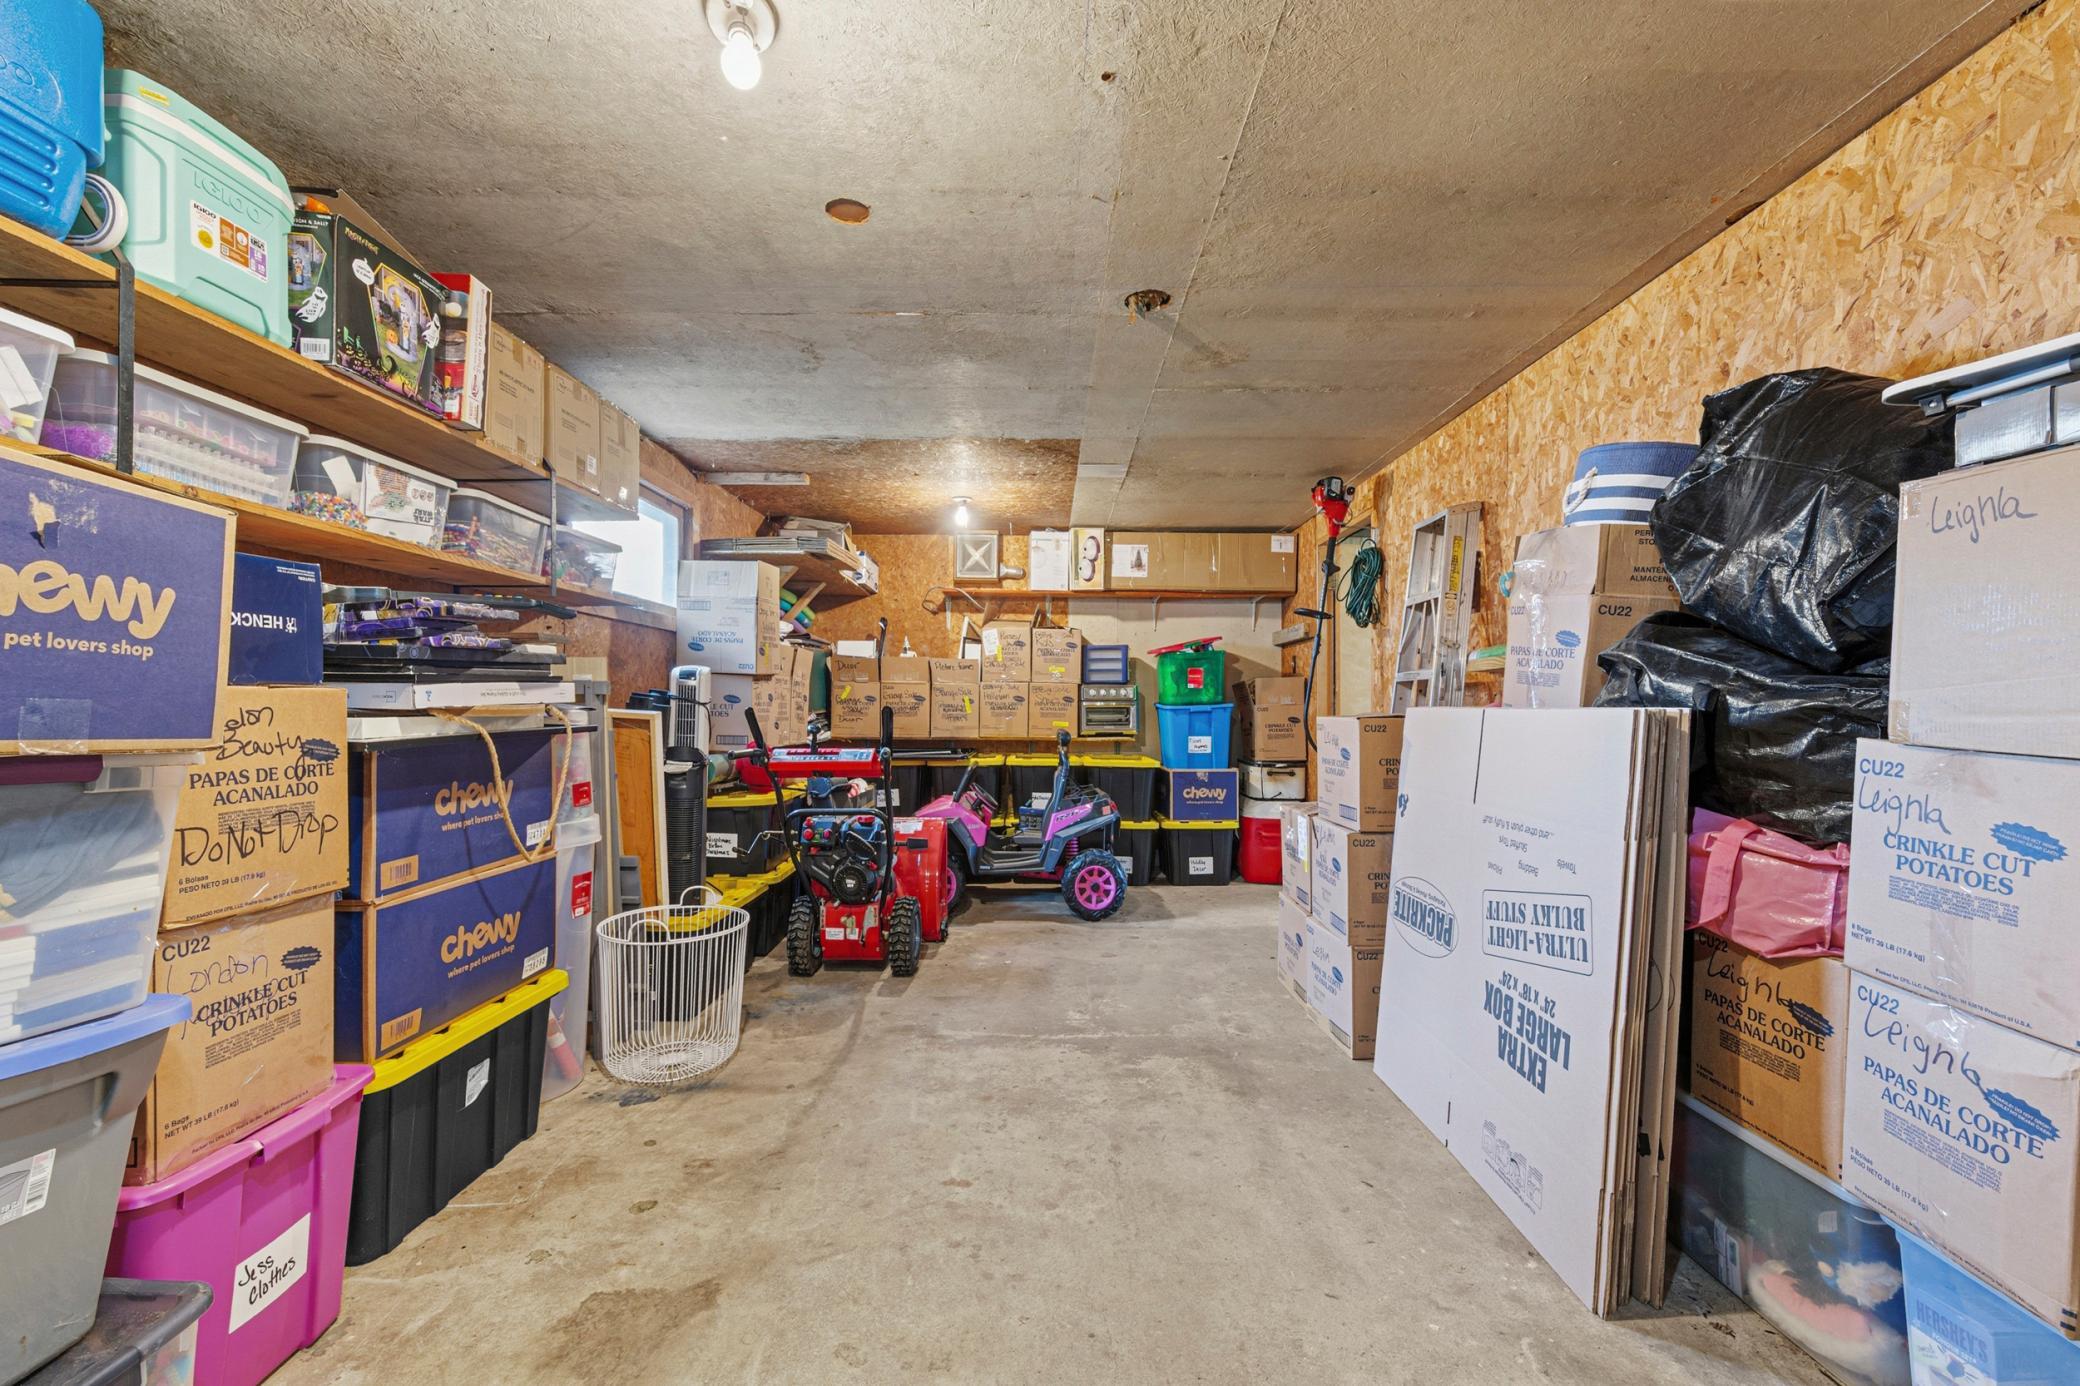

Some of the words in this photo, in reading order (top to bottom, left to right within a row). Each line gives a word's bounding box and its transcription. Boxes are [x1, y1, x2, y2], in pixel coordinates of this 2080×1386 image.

[1630, 575, 1672, 583] ALMACEN
[1633, 566, 1667, 574] MANTEN
[0, 560, 176, 640] ewy
[1598, 604, 1633, 617] CU22
[230, 611, 283, 630] HENCK
[4, 632, 42, 650] pet
[47, 632, 107, 654] lovers
[111, 638, 154, 661] shop
[1510, 646, 1532, 657] PAPAS
[1545, 646, 1576, 659] CORTE
[1516, 657, 1564, 670] ACALADO
[1363, 724, 1388, 733] CU22
[189, 768, 250, 790] PAPAS
[255, 766, 279, 783] DE
[283, 762, 335, 782] CORTE
[1378, 757, 1401, 767] CRIN
[1859, 758, 1905, 778] CU22
[213, 780, 319, 807] ACANALADO
[434, 779, 514, 816] chewy
[1182, 786, 1227, 801] chewy
[463, 817, 474, 829] pet
[1352, 838, 1377, 848] CU22
[1510, 839, 1528, 853] Stuffed
[1883, 831, 1975, 866] CRINKLE
[1982, 852, 2037, 878] CUT
[1367, 871, 1392, 881] CRIN
[1518, 859, 1539, 877] Bedding
[1556, 858, 1577, 875] Towels
[1896, 854, 2014, 896] POTATOES
[179, 885, 199, 895] PESO
[200, 880, 220, 891] NETO
[1394, 890, 1455, 949] PACKRITE
[1486, 900, 1527, 924] STUFF
[1530, 903, 1586, 932] BULKY
[162, 935, 211, 963] CU22
[440, 911, 521, 964] chewy
[1488, 925, 1589, 963] ULTRA-LIGHT
[1851, 931, 1864, 941] NET
[1356, 951, 1379, 961] CU22
[195, 982, 273, 1024] CRINKLE
[277, 969, 309, 991] CUT
[1483, 979, 1514, 1029] BOX
[1857, 985, 1900, 1015] CU22
[211, 991, 298, 1037] POTATOES
[1704, 989, 1744, 1016] PAPAS
[1747, 1006, 1767, 1026] DE
[1771, 1017, 1826, 1052] CORTE
[1515, 1001, 1571, 1071] LARGE
[1717, 1010, 1805, 1060] ACANALADO
[1498, 1024, 1547, 1094] EXTRA
[1864, 1055, 1918, 1097] PAPAS
[1923, 1084, 1951, 1114] DE
[1958, 1105, 2045, 1160] CORTE
[164, 1127, 180, 1140] NET
[182, 1121, 193, 1132] WT
[1881, 1085, 2011, 1164] ACANALADO
[1866, 1165, 1882, 1182] NETO
[237, 1255, 275, 1287] Jess
[248, 1255, 297, 1306] Clothes
[1917, 1299, 1988, 1364] HERSHEY'S
